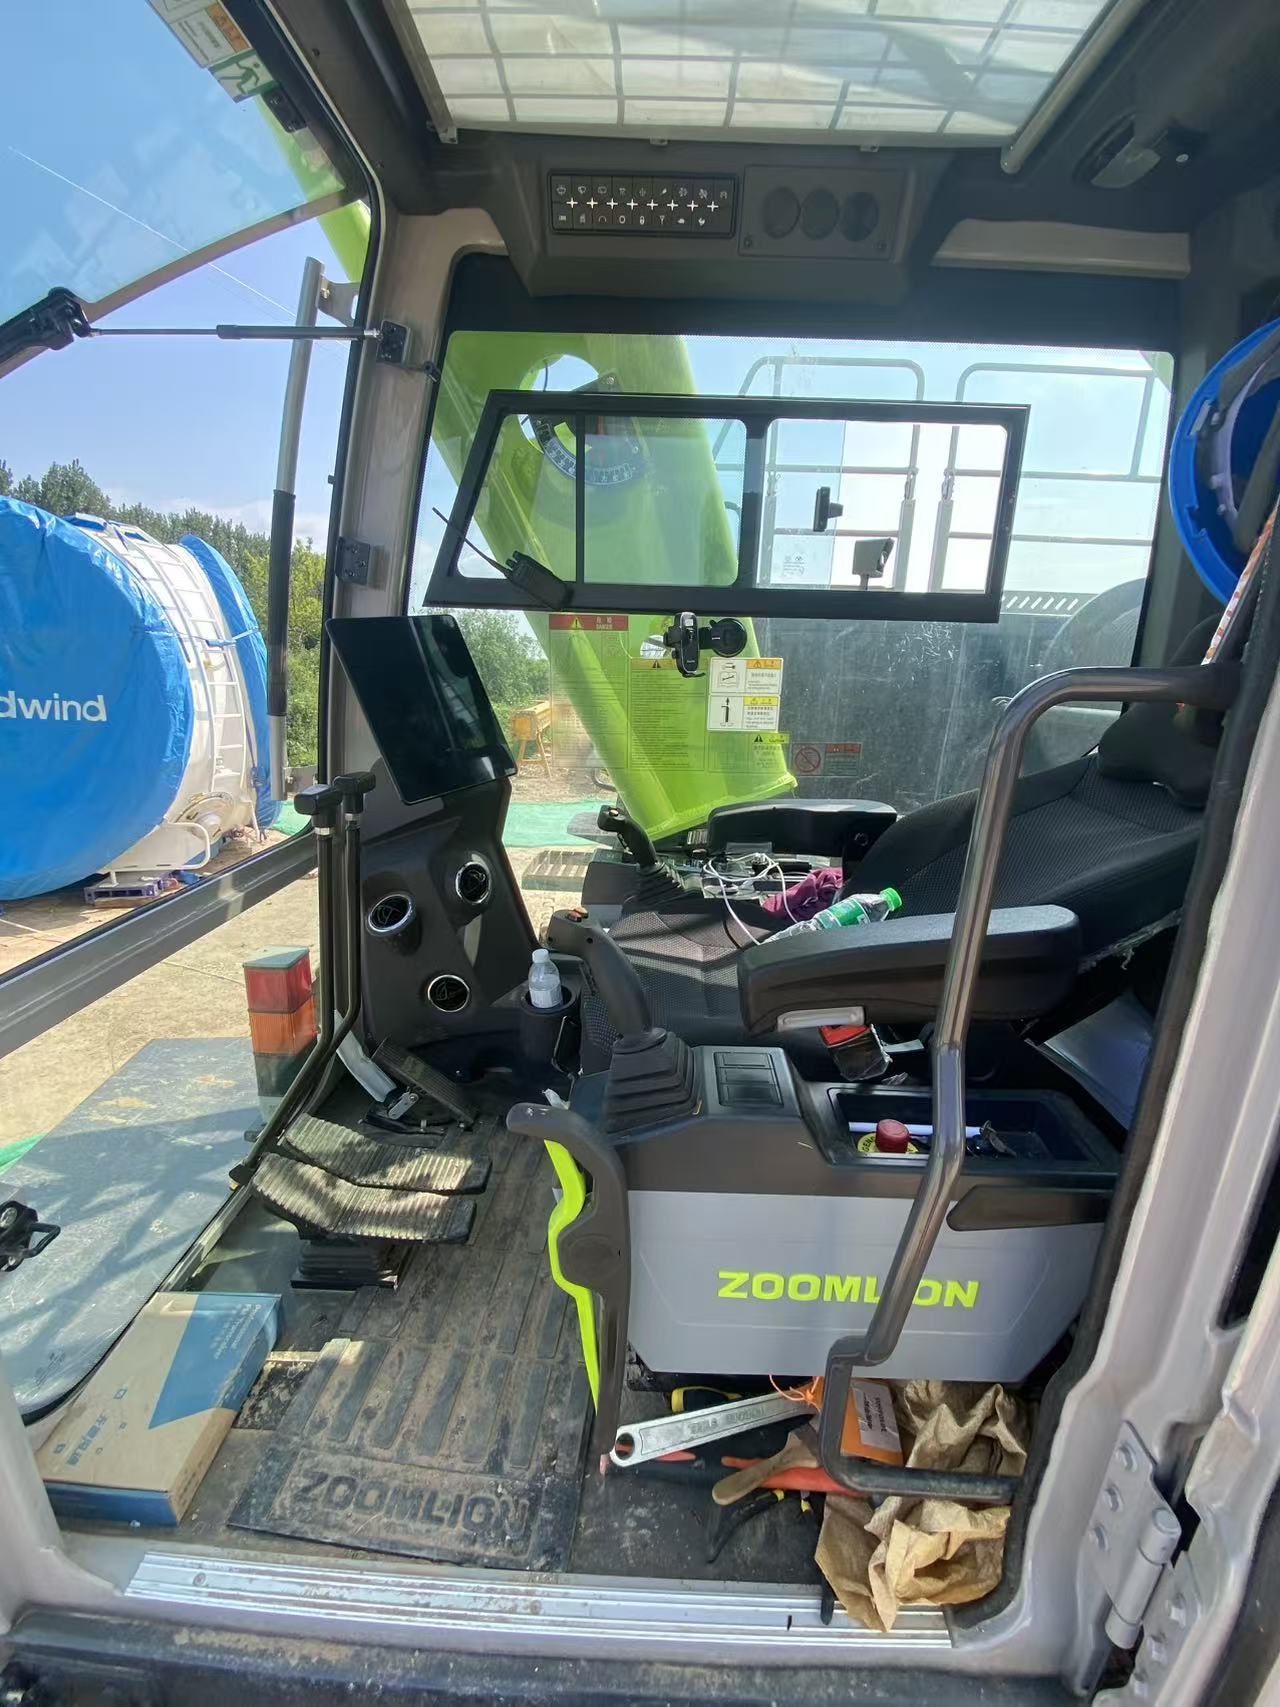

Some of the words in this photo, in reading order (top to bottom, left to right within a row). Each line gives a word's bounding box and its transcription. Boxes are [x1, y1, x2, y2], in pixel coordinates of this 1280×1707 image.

[0, 690, 107, 722] dwind
[717, 1270, 980, 1308] ZOOMLON
[292, 1470, 531, 1541] ZOOMLION
